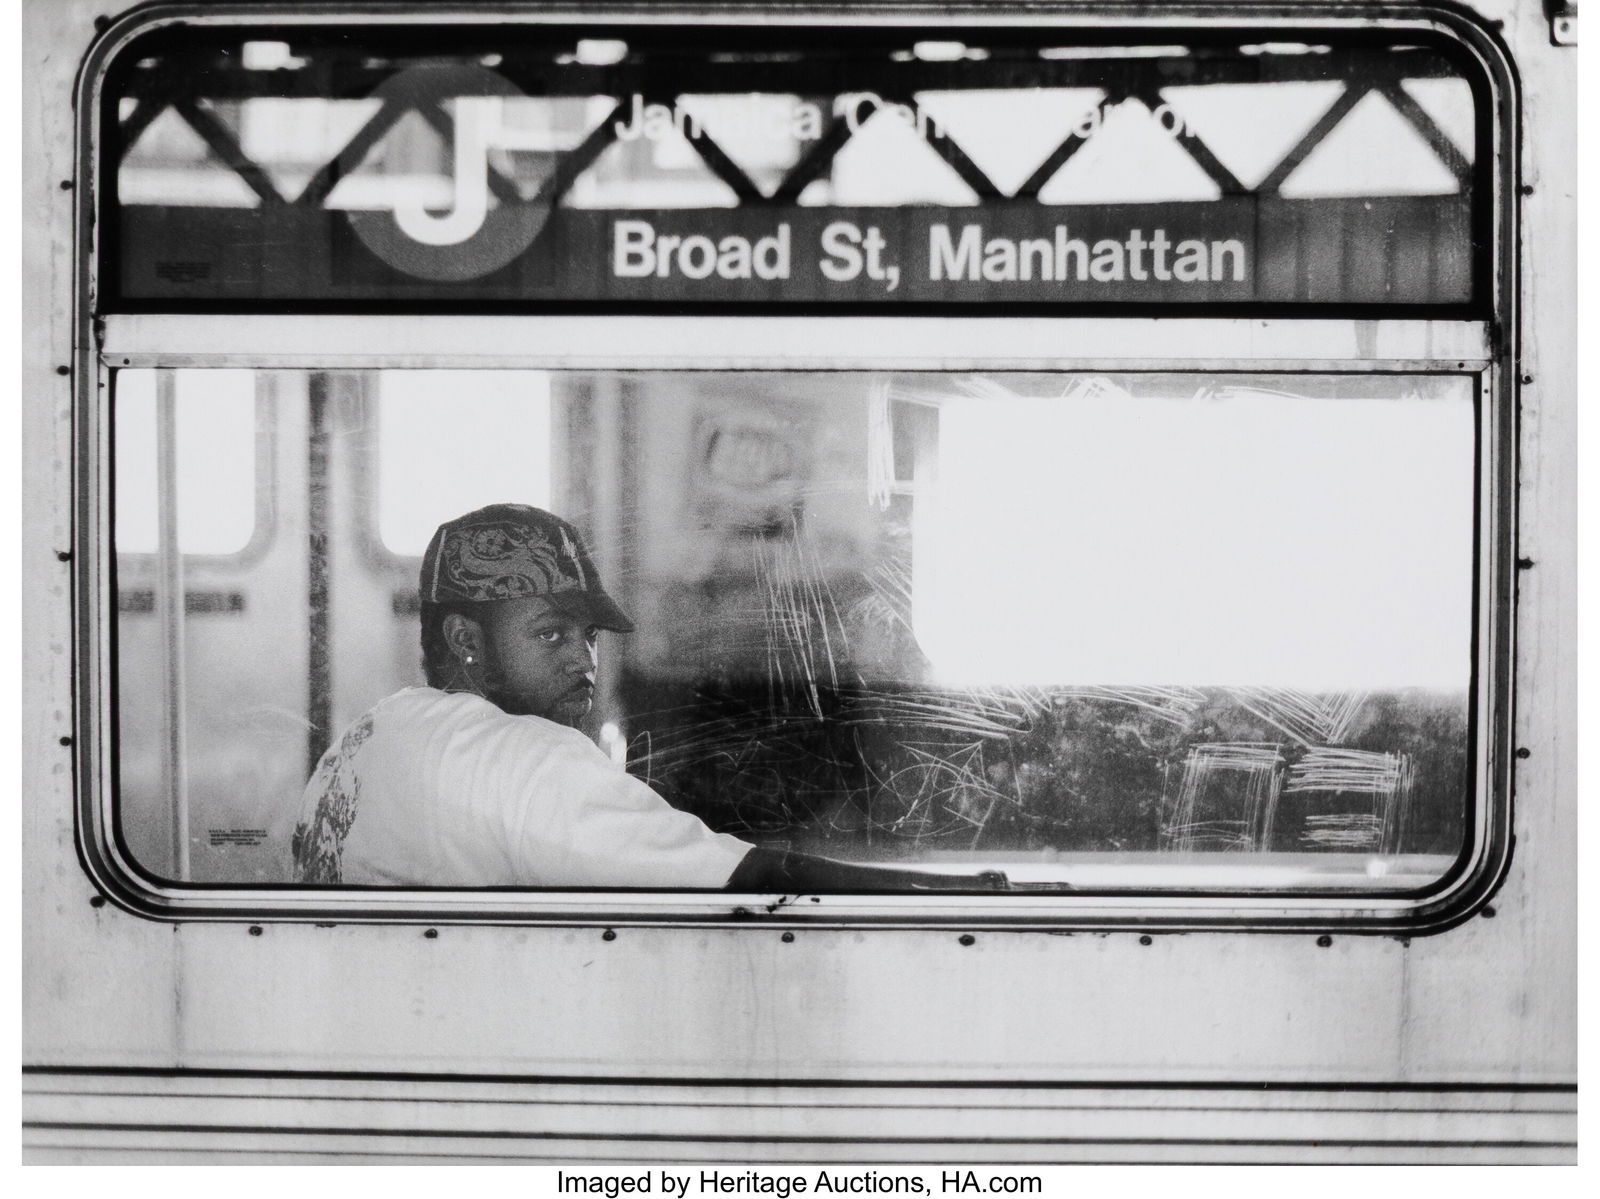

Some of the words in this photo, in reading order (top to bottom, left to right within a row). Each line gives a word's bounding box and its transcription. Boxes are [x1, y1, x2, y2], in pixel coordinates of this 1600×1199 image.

[394, 97, 487, 246] J
[613, 221, 790, 281] Broad
[819, 221, 901, 291] St,
[928, 223, 1247, 284] Manhattan
